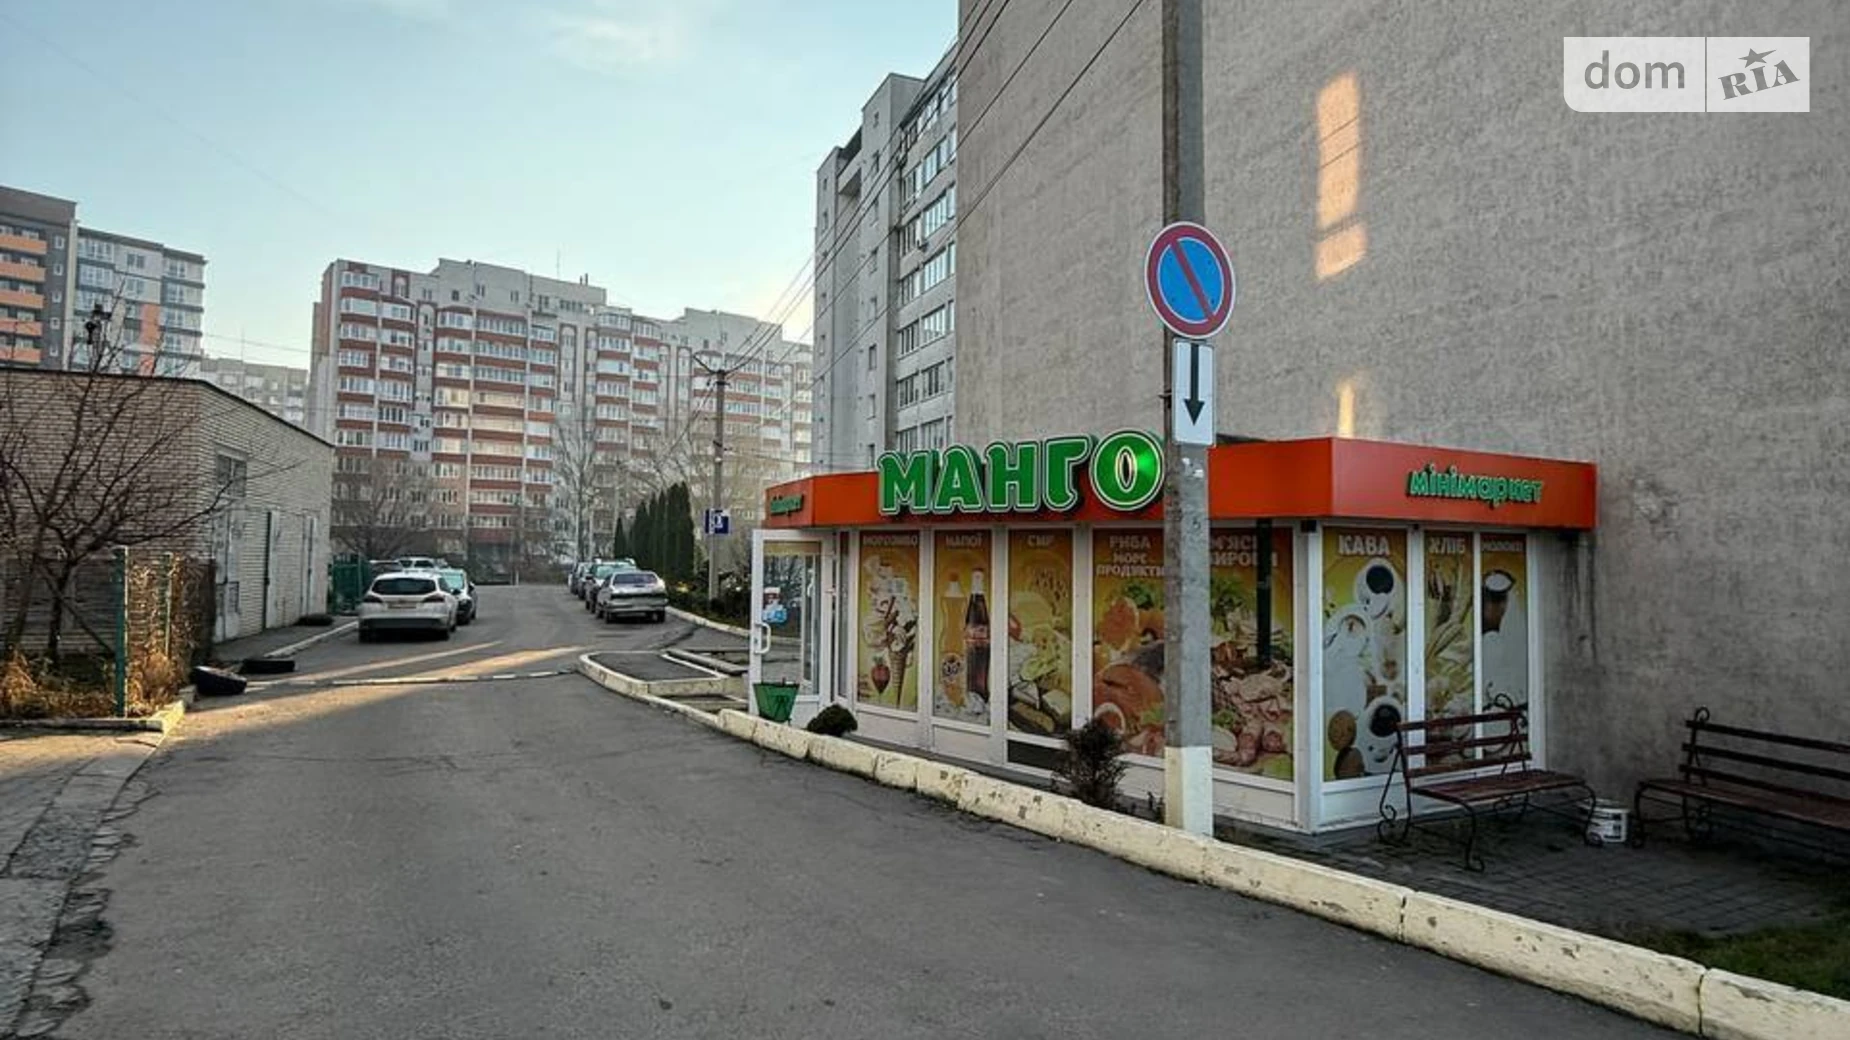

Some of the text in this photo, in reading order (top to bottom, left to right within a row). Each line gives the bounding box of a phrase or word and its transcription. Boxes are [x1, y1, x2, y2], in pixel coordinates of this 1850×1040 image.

[878, 429, 1165, 515] МАНГО
[1407, 462, 1543, 509] мінімаркет
[946, 532, 983, 547] НАПОЇ
[1109, 535, 1151, 549] РИБА
[1338, 534, 1390, 556] КАВА
[1428, 536, 1466, 554] ХЛІБ
